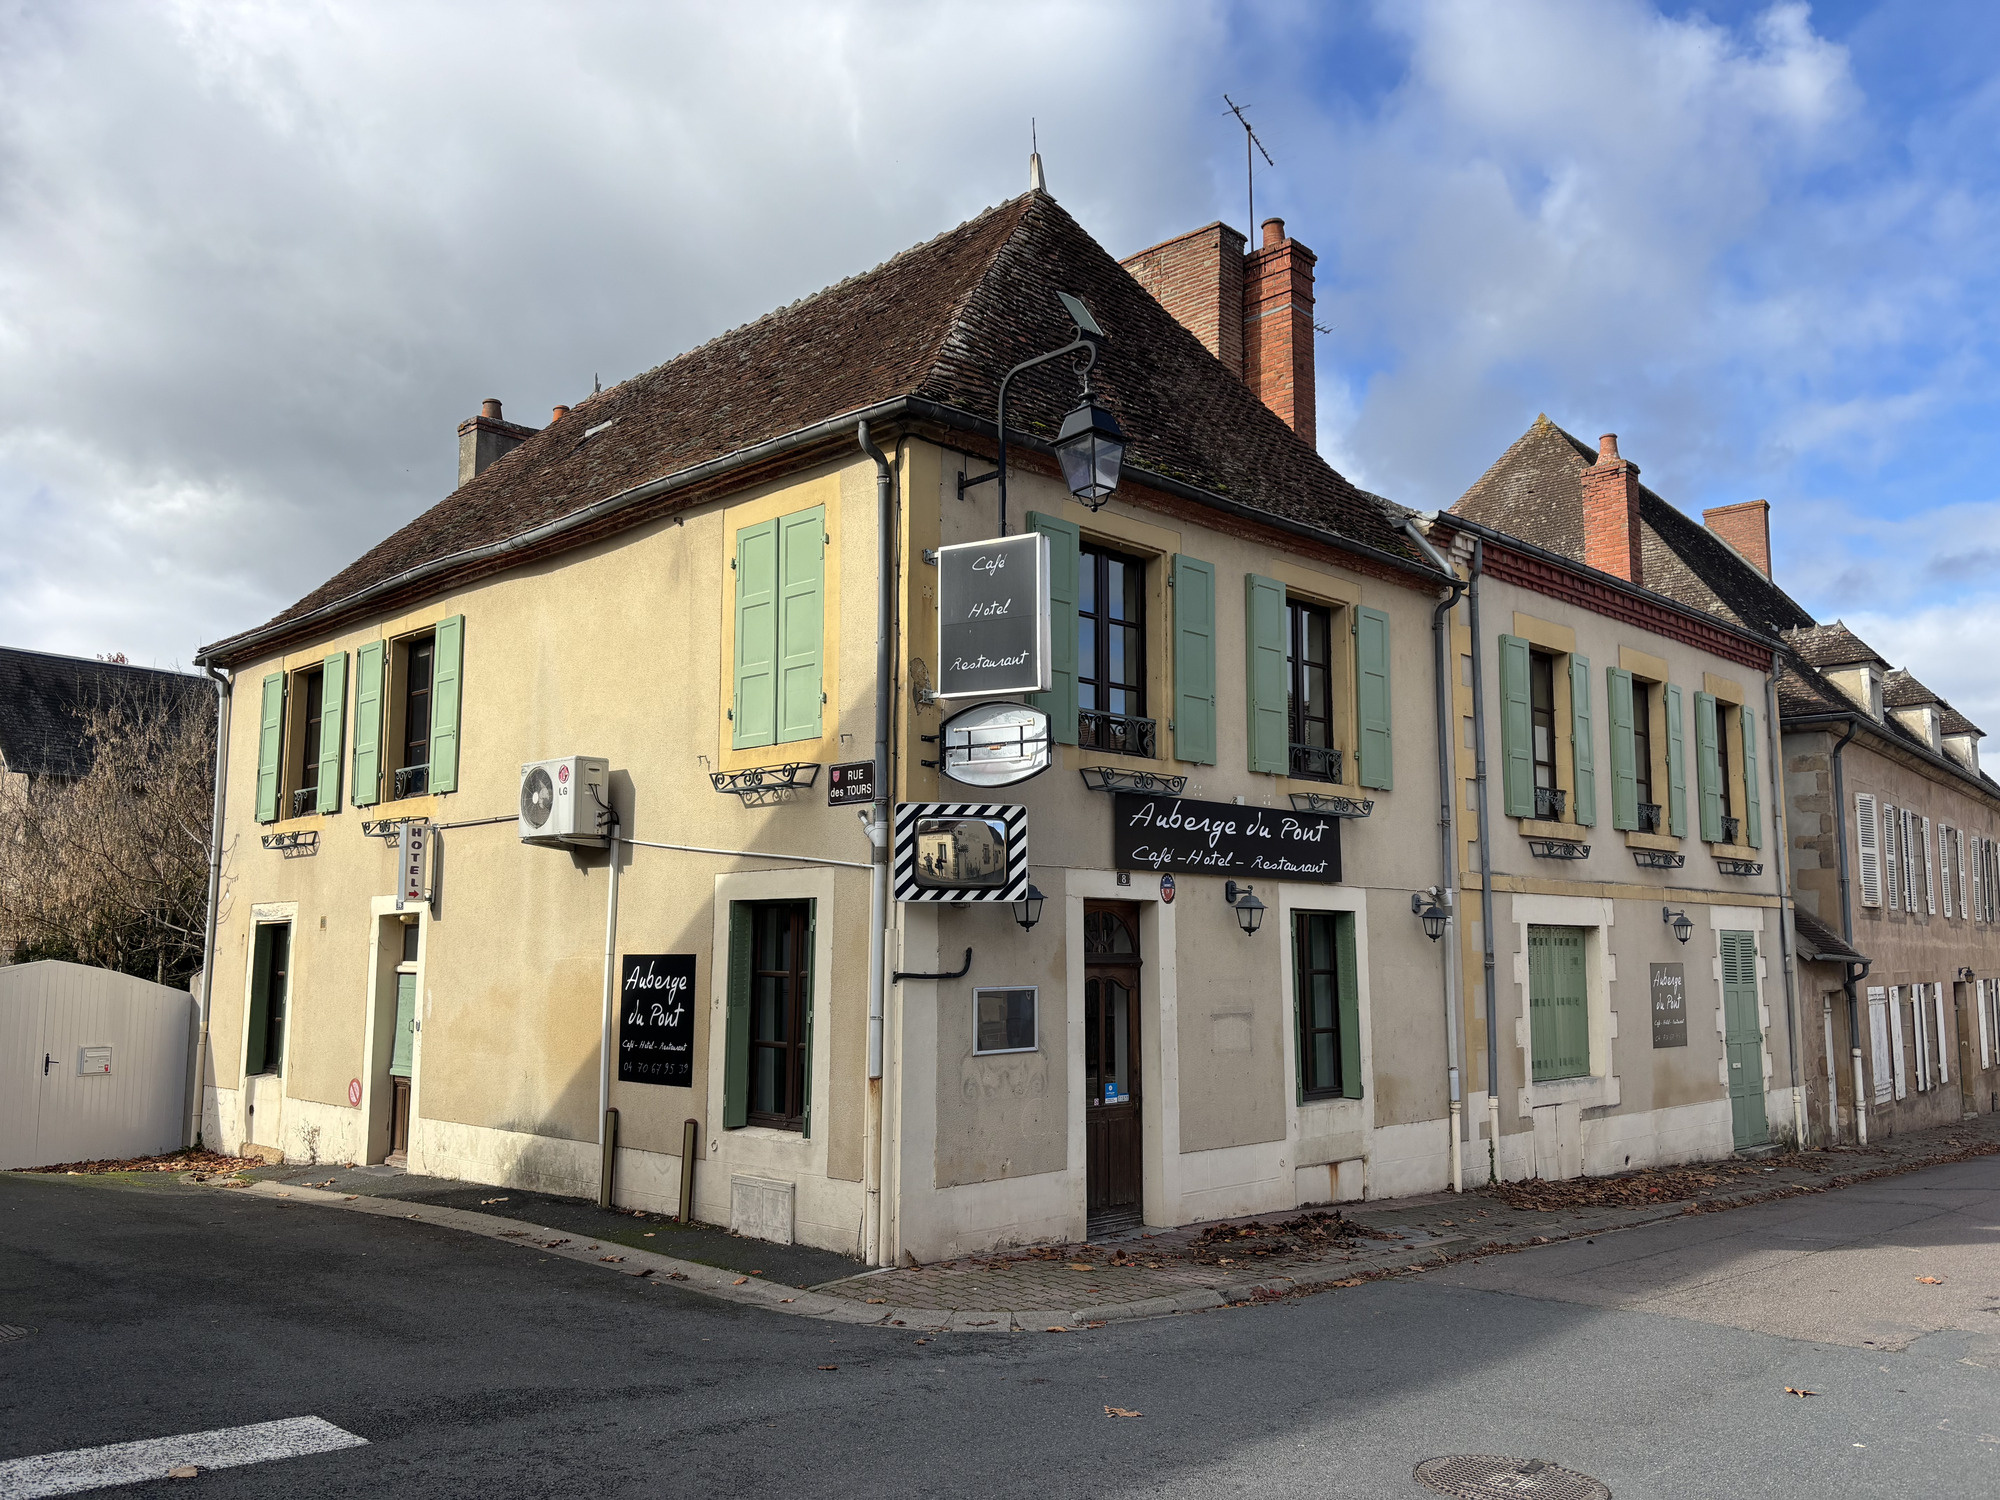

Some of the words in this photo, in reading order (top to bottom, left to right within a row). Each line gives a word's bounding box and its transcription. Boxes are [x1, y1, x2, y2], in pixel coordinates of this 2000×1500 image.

[972, 554, 1007, 577] Café
[968, 599, 1011, 618] Hotel
[949, 650, 1029, 671] Restaurant
[848, 769, 863, 780] RUE
[558, 786, 568, 796] LG
[830, 788, 844, 798] des
[847, 783, 872, 795] TOURS
[1129, 800, 1236, 848] Auberge
[1246, 812, 1271, 839] du
[1281, 818, 1329, 842] Pont
[410, 828, 422, 887] HOTEL
[1132, 845, 1174, 869] Café
[1186, 850, 1233, 867] Hotel
[1251, 855, 1328, 874] Restaurant
[1121, 874, 1127, 884] 8
[625, 961, 687, 1005] Auberge
[1653, 968, 1682, 995] Auberge
[1666, 993, 1682, 1010] Pont
[628, 999, 644, 1026] du
[650, 1002, 685, 1027] Pont
[623, 1061, 632, 1072] 04
[637, 1062, 648, 1073] 70
[651, 1062, 662, 1075] 67
[664, 1062, 675, 1075] 95
[678, 1063, 689, 1074] 39
